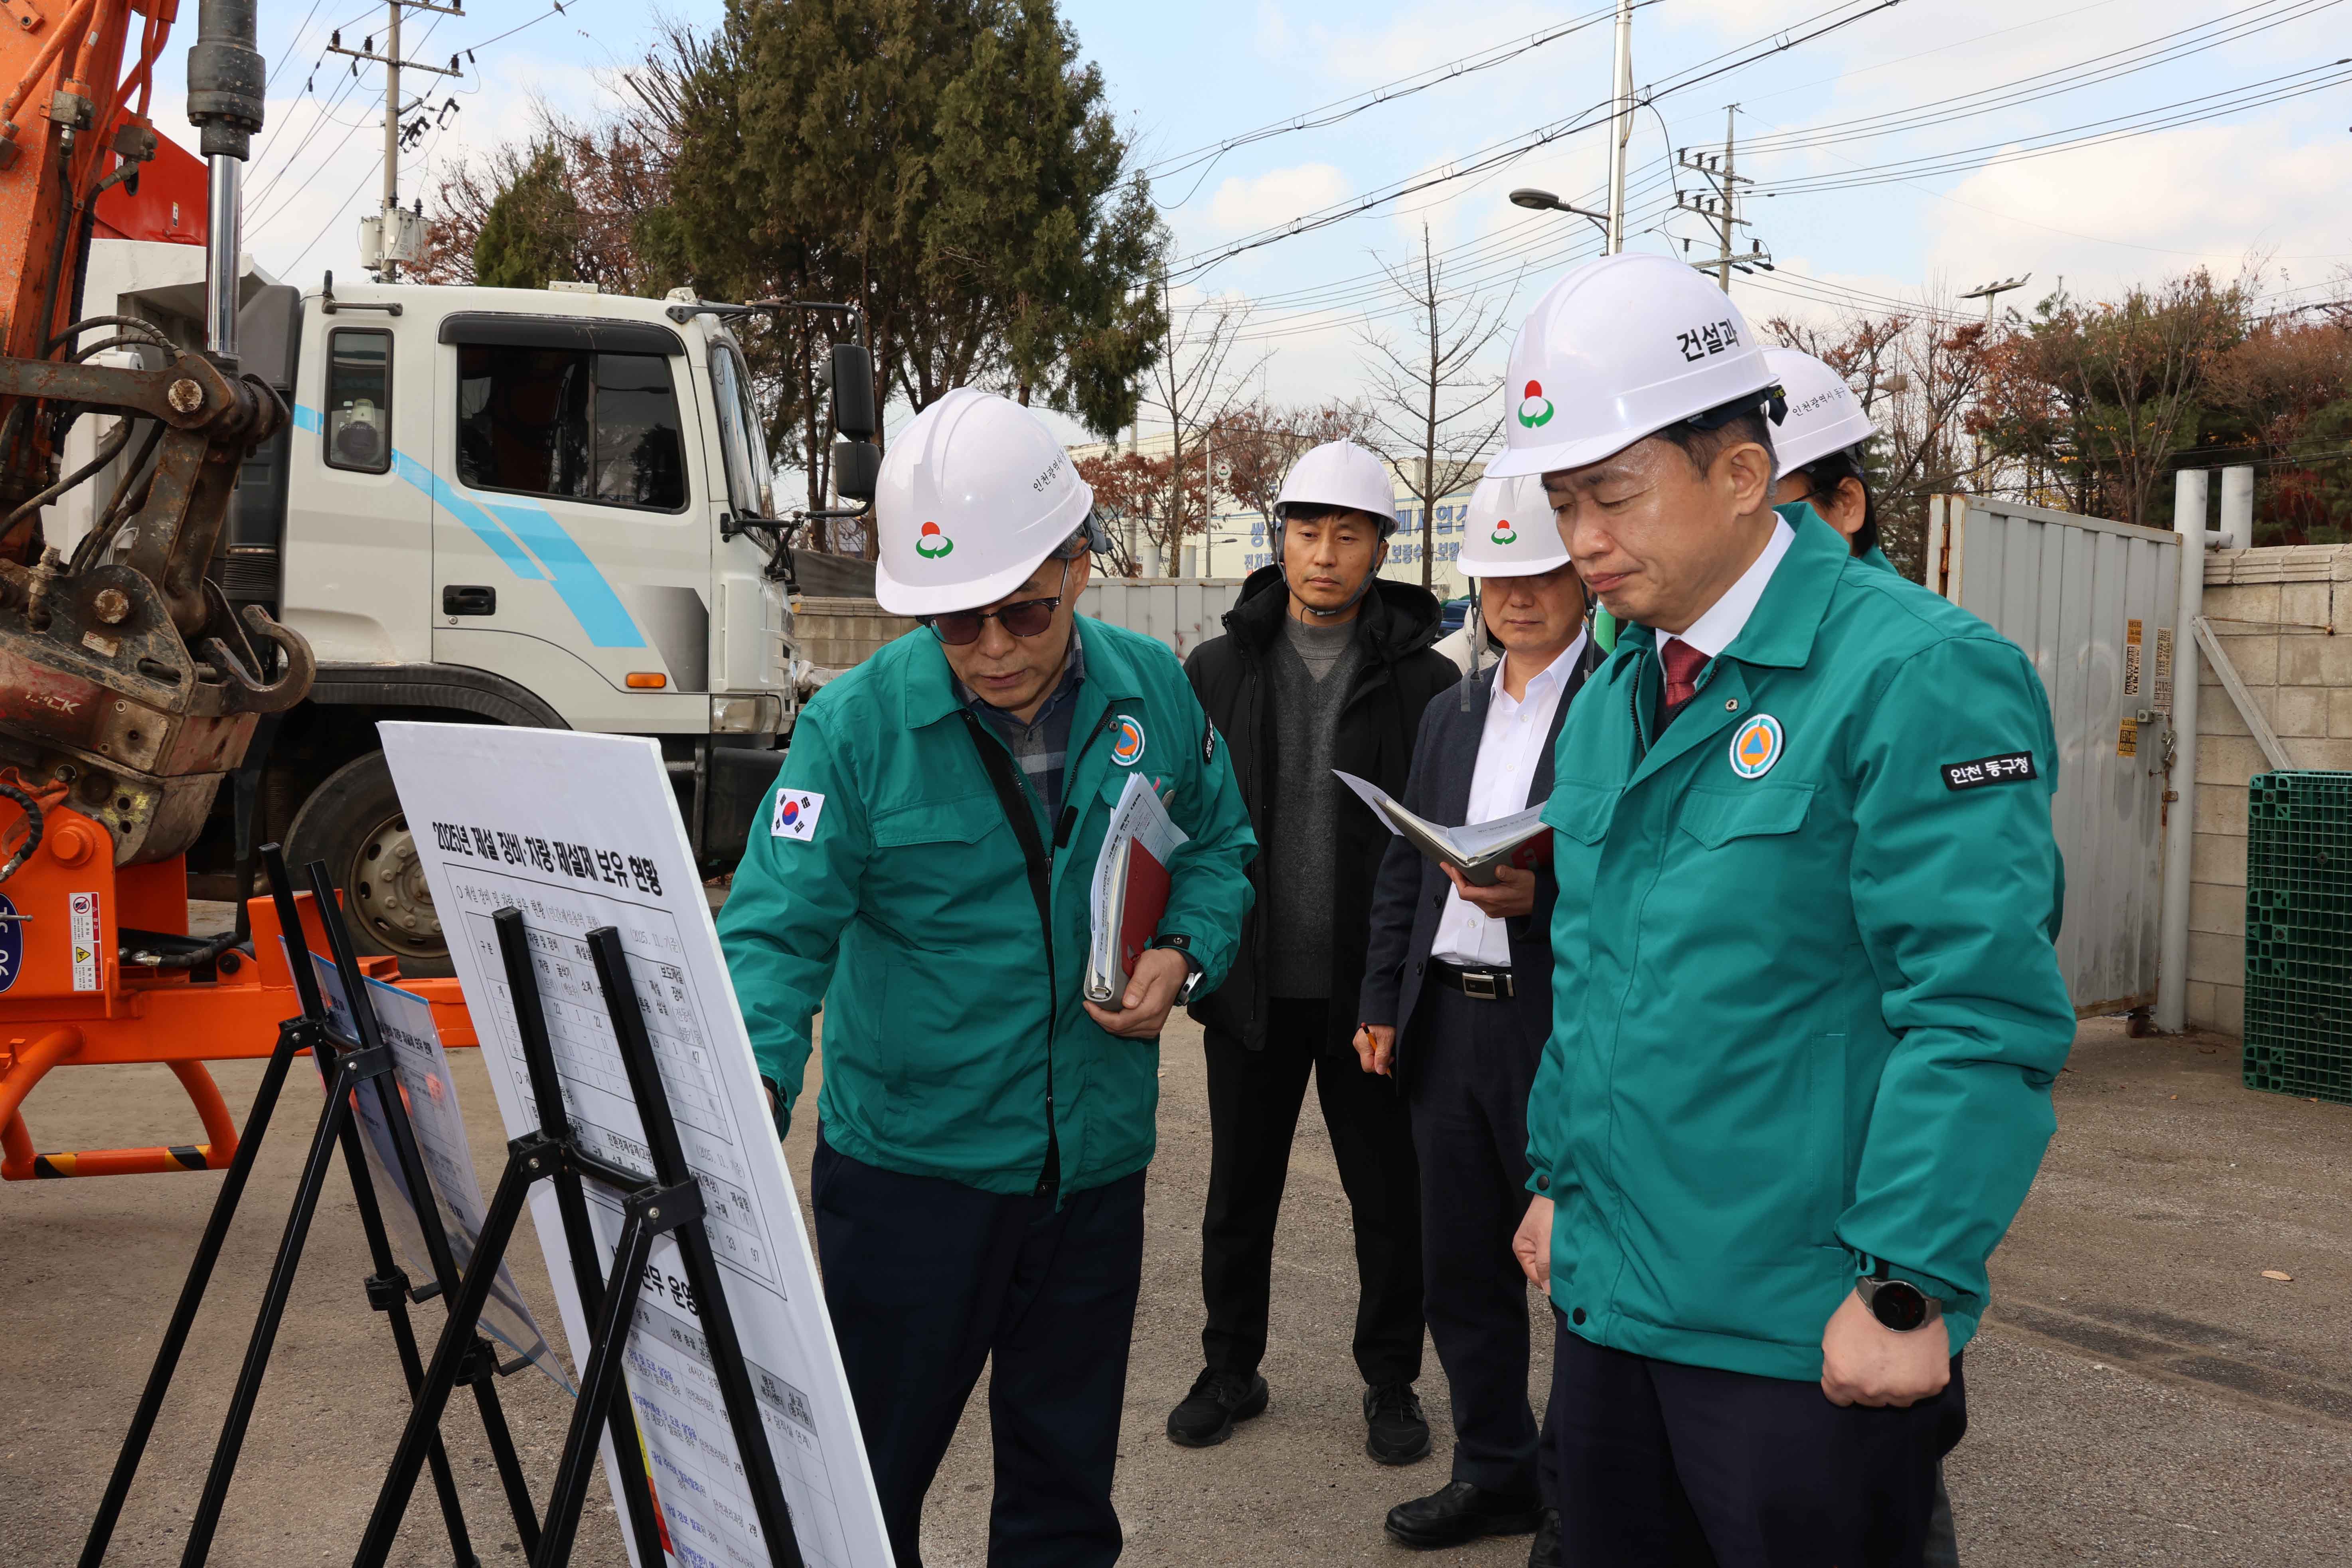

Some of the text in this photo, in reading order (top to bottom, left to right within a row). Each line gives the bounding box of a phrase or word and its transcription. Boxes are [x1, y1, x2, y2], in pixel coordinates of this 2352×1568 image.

[1676, 318, 1740, 362] 건설과
[1792, 391, 1835, 416] 인천광역시
[1033, 454, 1064, 492] 인천광역시
[1951, 757, 2028, 784] 인천 동구청
[432, 822, 473, 856] 2025년
[470, 827, 500, 861] 제설
[595, 849, 629, 888] 보유
[628, 855, 663, 897] 현황
[492, 891, 502, 908] 및
[516, 898, 530, 915] 보유
[531, 900, 546, 919] 현황
[556, 964, 573, 980] 굴삭기
[660, 965, 684, 985] 보도제설
[671, 986, 686, 1004] 장비
[553, 1002, 562, 1015] 22
[594, 1015, 602, 1029] 22
[651, 1034, 660, 1049] 19
[692, 1050, 700, 1064] 47
[730, 1191, 750, 1213] 제설함
[726, 1235, 736, 1251] 33
[750, 1247, 760, 1263] 97
[687, 1363, 706, 1382] 24시간
[762, 1374, 776, 1392] 행정
[774, 1416, 794, 1438] 당직실
[734, 1461, 744, 1476] 2명
[748, 1523, 758, 1538] 2명
